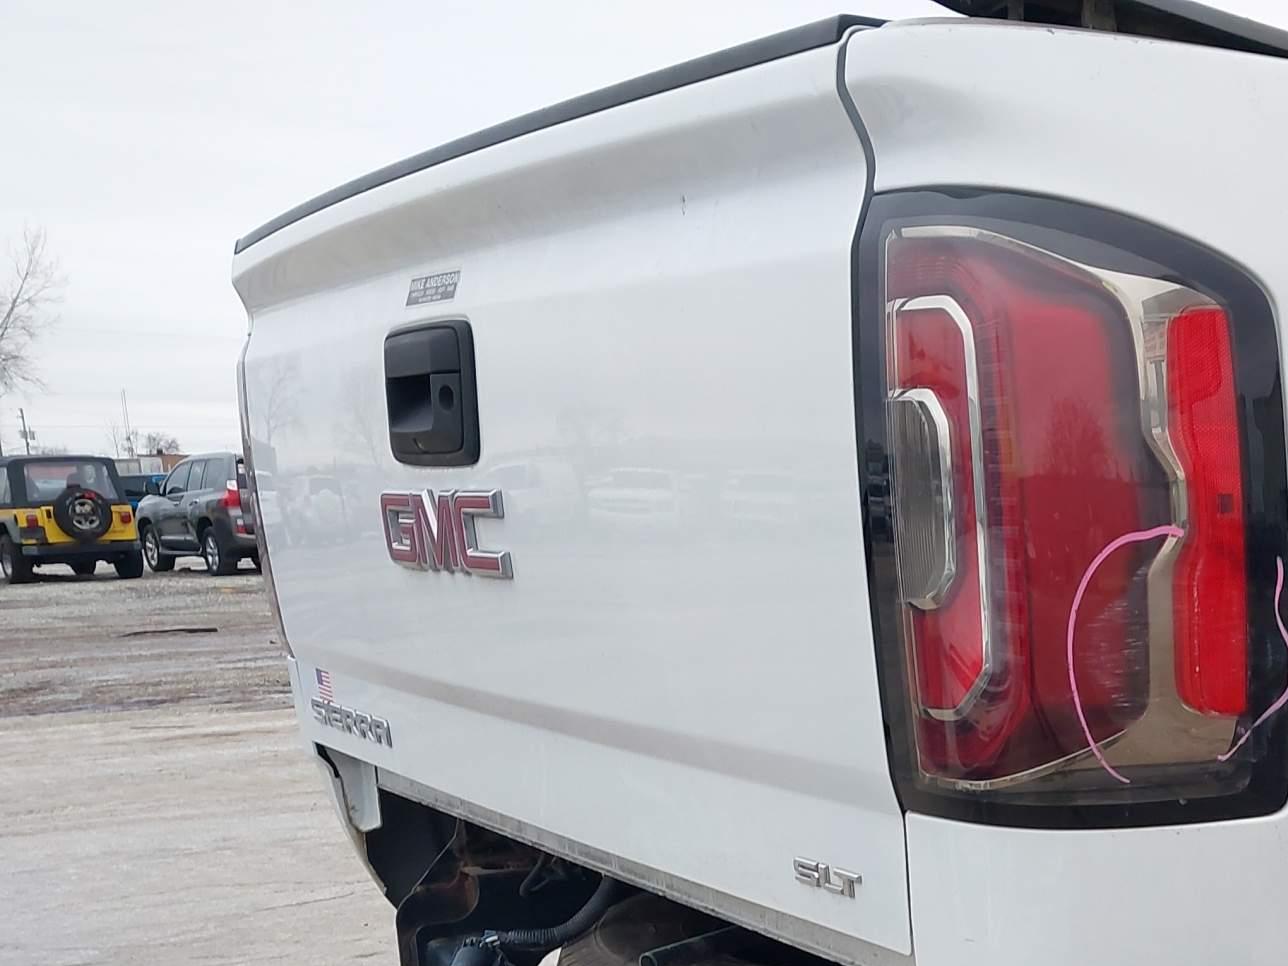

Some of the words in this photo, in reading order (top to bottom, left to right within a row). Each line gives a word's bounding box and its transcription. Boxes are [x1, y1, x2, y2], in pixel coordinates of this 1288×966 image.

[379, 488, 514, 579] GMC
[310, 697, 393, 749] SIERRA
[793, 856, 863, 899] SLT
